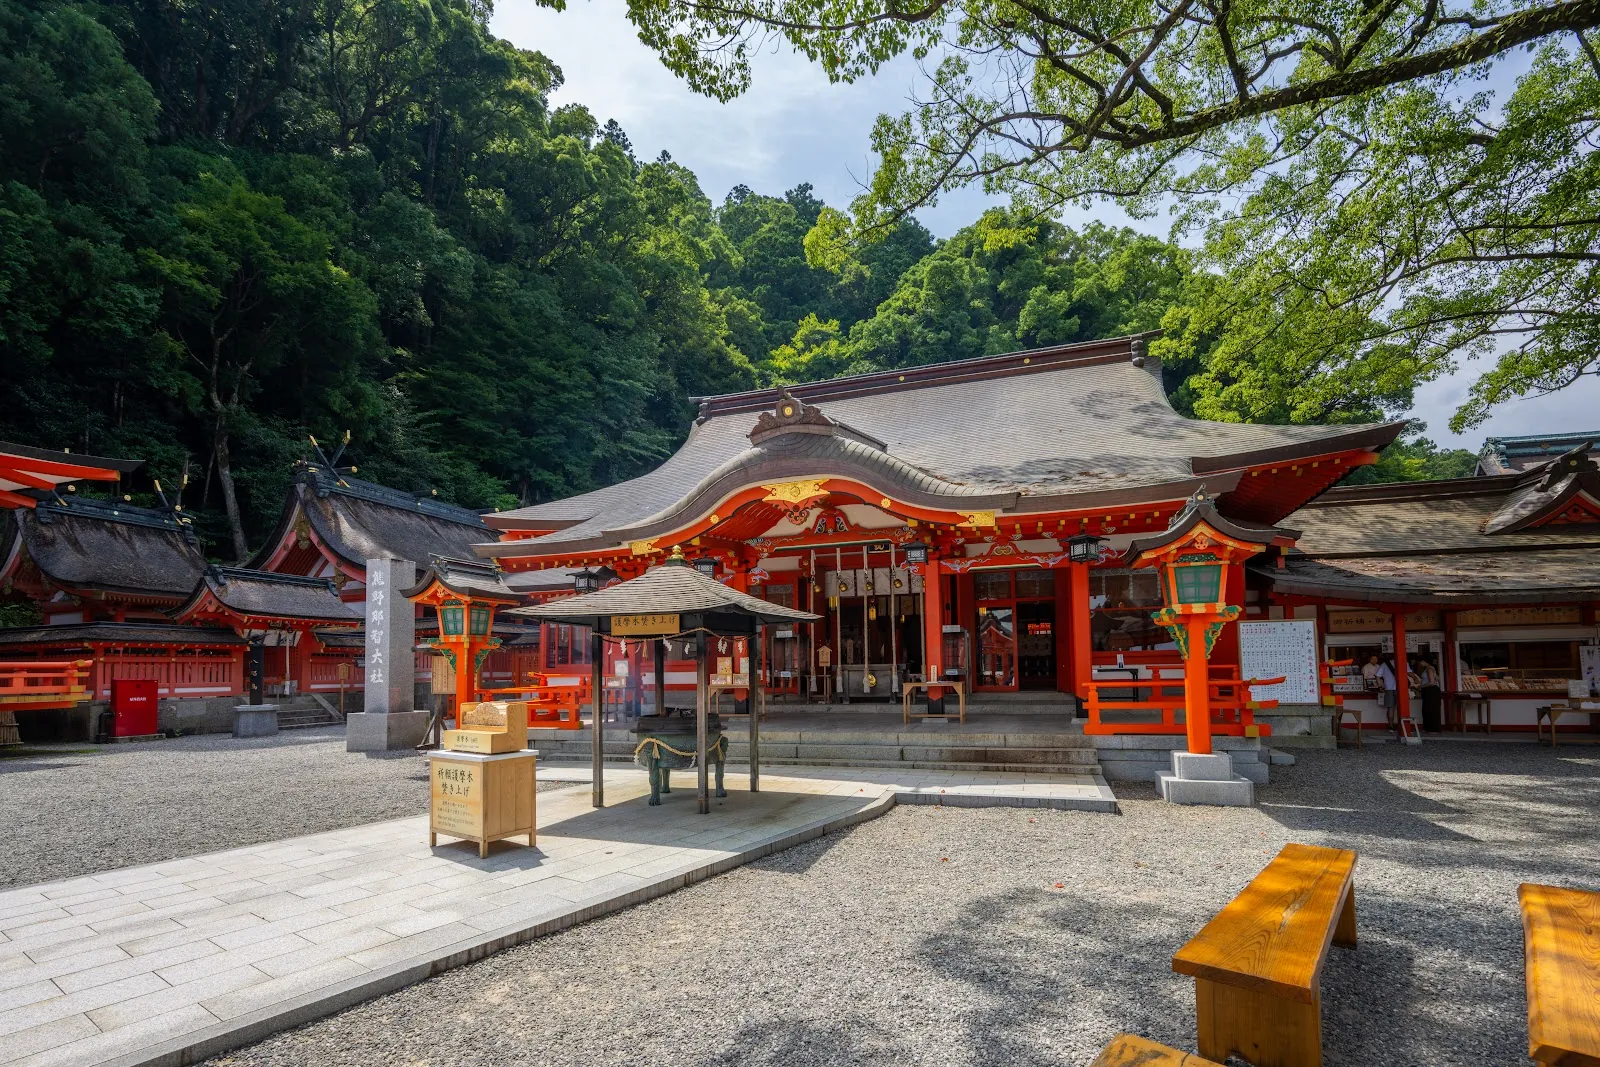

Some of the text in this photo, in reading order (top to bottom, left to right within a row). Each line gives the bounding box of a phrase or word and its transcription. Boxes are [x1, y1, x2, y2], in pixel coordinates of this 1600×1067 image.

[370, 570, 385, 684] 熊野那智大社
[613, 615, 676, 627] 護摩木焚き上げ
[1413, 615, 1436, 624] 受付
[437, 768, 474, 783] 祈願護摩木
[441, 782, 470, 797] 焚き上げ
